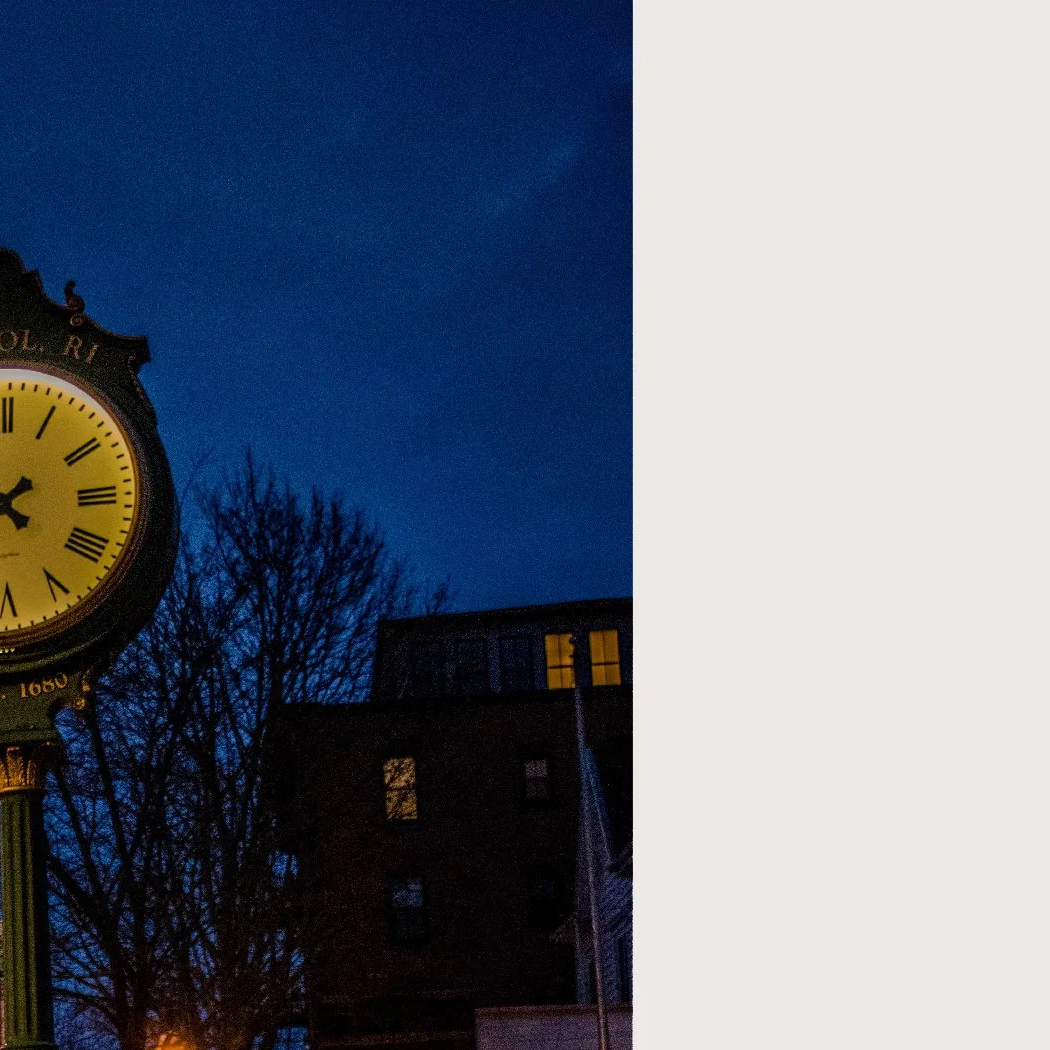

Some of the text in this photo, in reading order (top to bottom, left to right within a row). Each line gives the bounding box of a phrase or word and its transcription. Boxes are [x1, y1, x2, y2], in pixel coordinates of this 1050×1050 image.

[61, 335, 100, 365] RI
[36, 405, 57, 440] I
[64, 437, 101, 466] II
[77, 485, 117, 507] III
[64, 527, 109, 563] IIII
[42, 567, 70, 602] V
[20, 672, 68, 698] 1680
